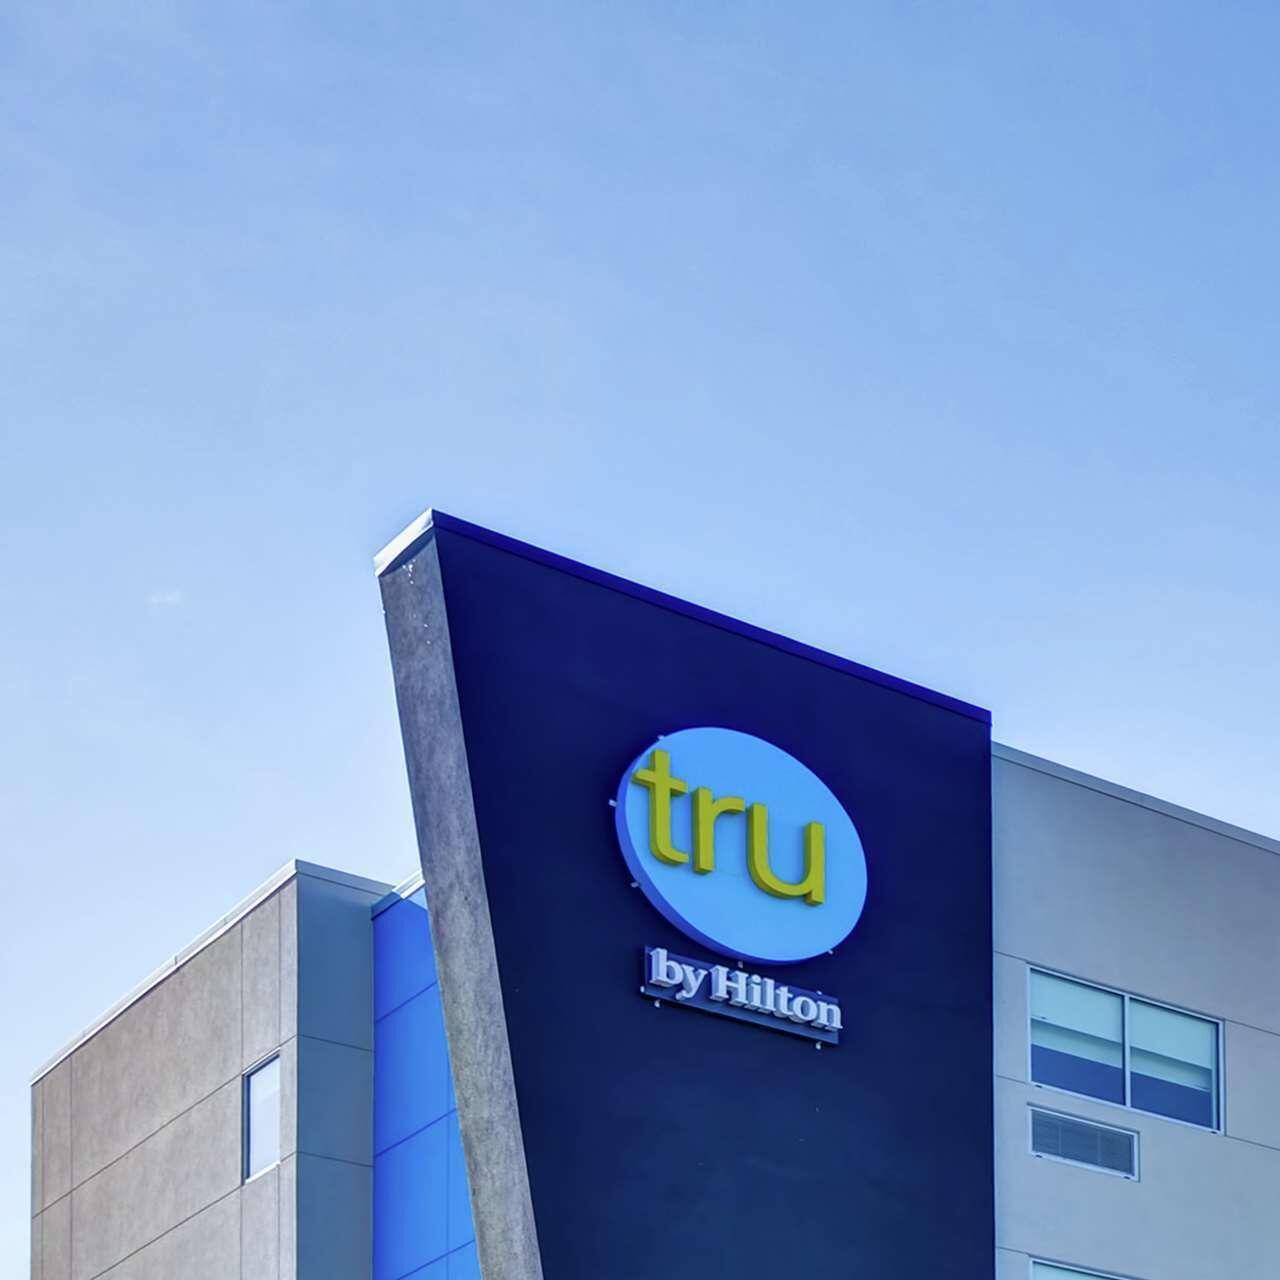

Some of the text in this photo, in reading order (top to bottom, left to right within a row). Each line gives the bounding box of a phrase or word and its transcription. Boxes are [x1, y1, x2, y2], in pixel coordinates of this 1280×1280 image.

[631, 748, 825, 905] tru
[649, 947, 843, 1030] by Hilton
